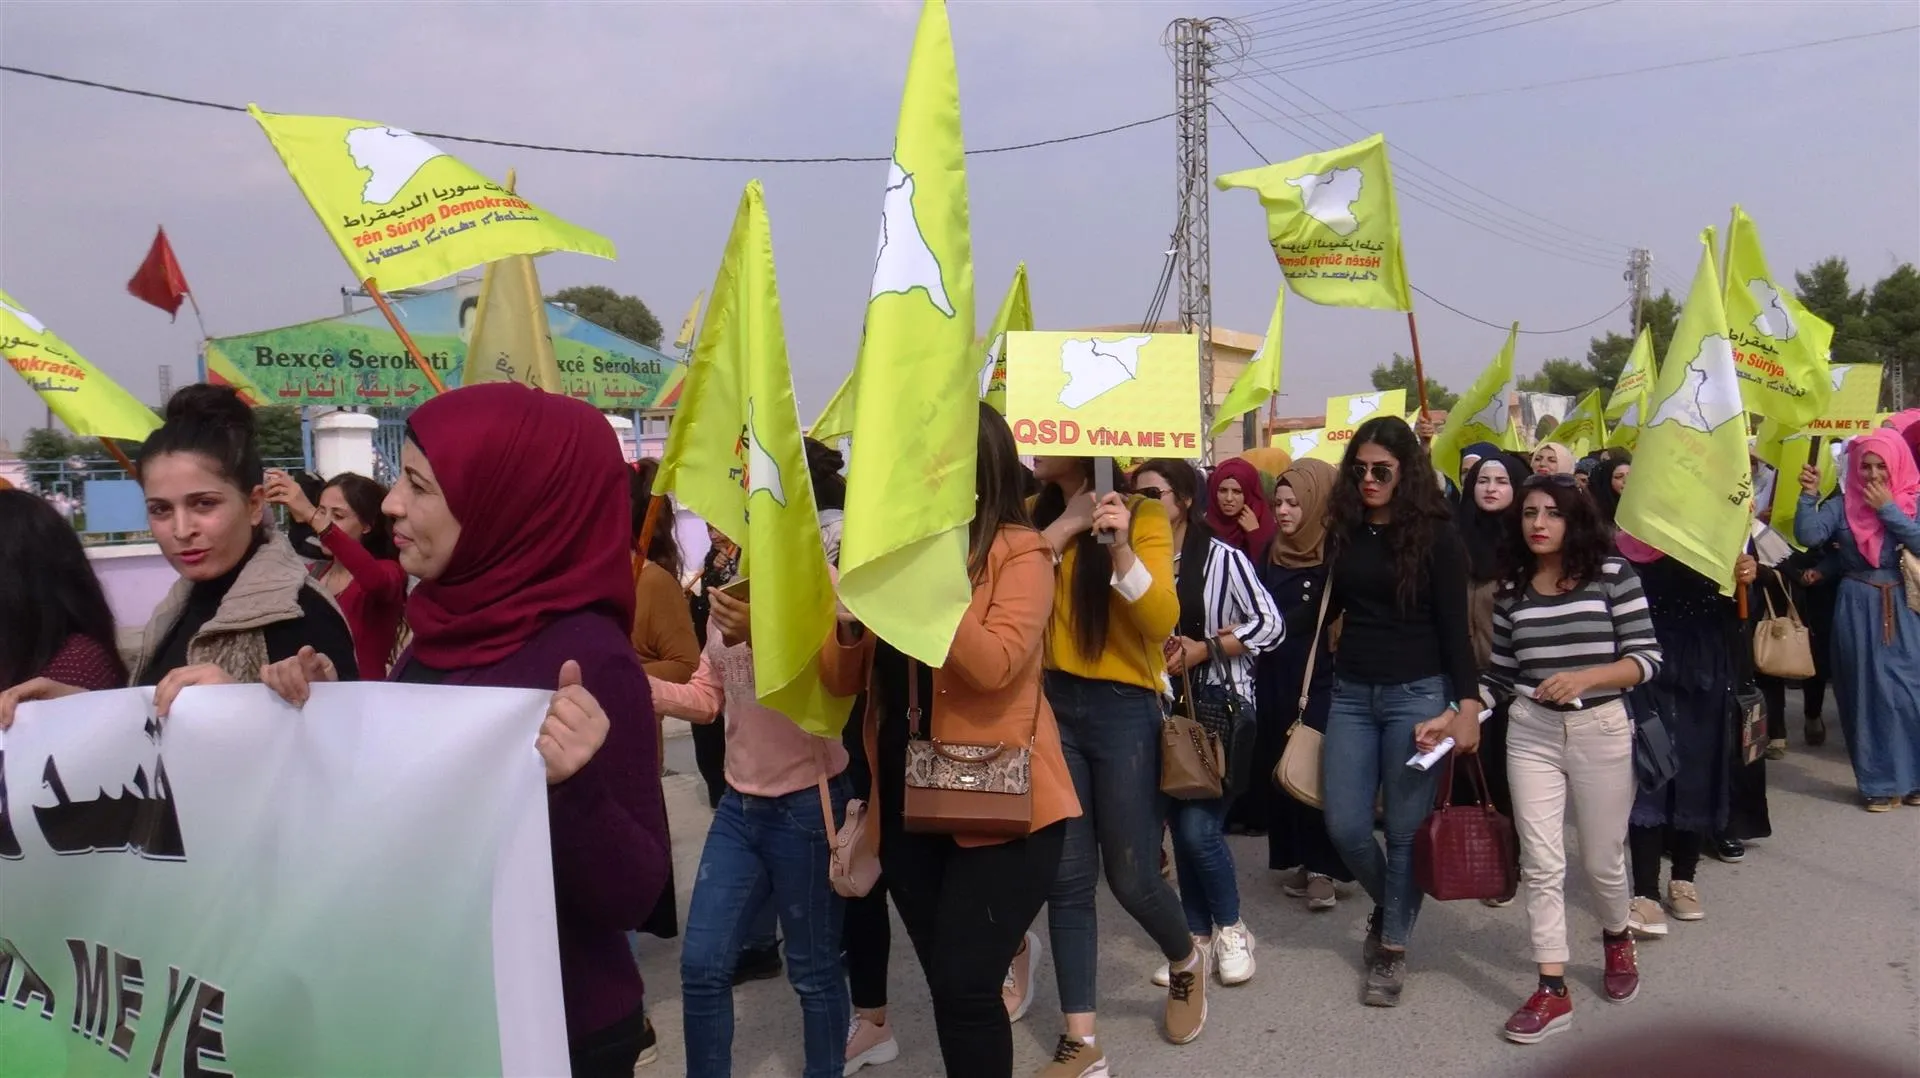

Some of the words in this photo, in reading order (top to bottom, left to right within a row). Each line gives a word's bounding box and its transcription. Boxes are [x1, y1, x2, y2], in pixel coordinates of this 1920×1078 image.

[432, 183, 480, 202] سوريا
[353, 229, 383, 249] zên
[438, 197, 533, 220] Demokratik
[255, 346, 336, 371] Bexçê
[348, 349, 449, 370] Seroktî
[556, 355, 585, 376] xçê
[593, 355, 662, 374] Serokatî
[1013, 419, 1081, 445] QSD
[1086, 427, 1133, 447] VÎNA
[1137, 431, 1166, 448] ME
[1170, 432, 1197, 448] YE
[1835, 419, 1852, 430] ME
[1855, 419, 1871, 430] YE
[65, 937, 145, 1062] ME
[149, 963, 236, 1078] YE
